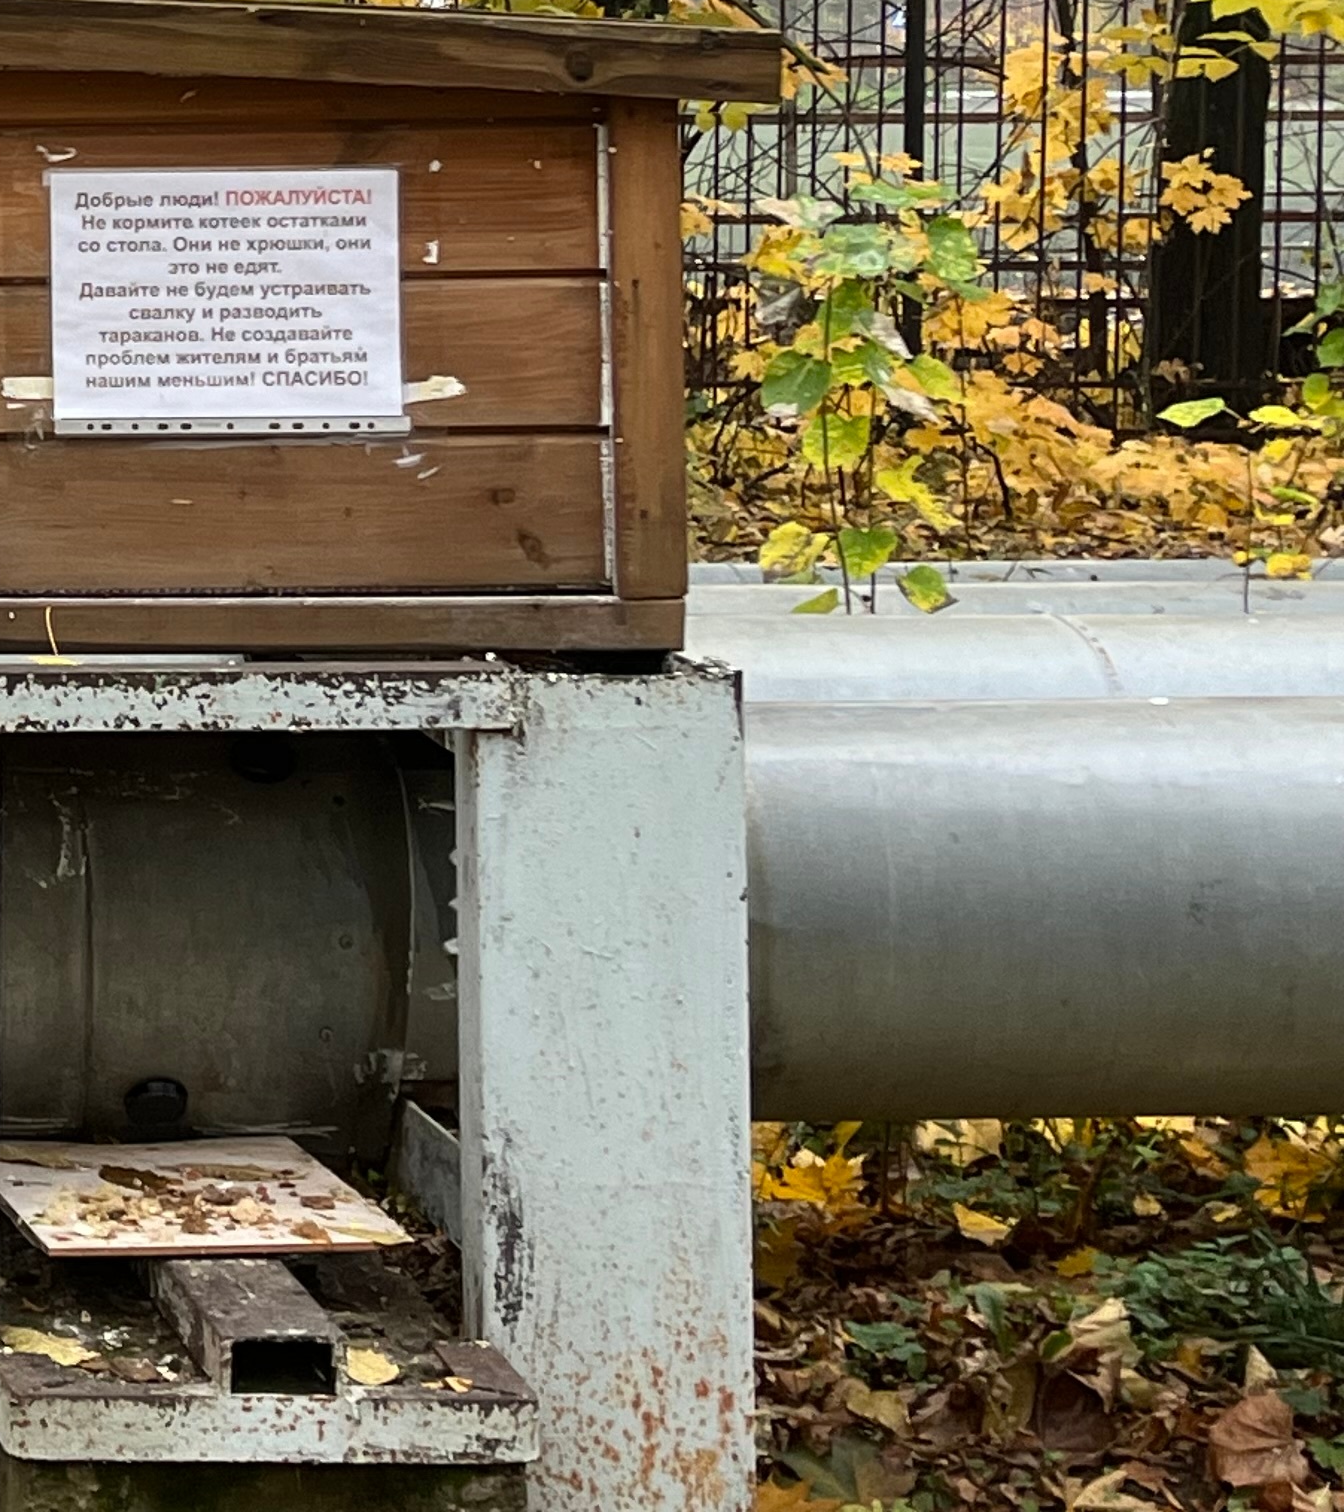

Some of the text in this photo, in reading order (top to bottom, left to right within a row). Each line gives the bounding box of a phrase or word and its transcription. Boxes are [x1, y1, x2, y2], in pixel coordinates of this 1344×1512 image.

[74, 186, 373, 210] Добрые люди! ПОЖАЛУЙСТА!
[81, 214, 367, 233] Не кормите котеек остатками
[78, 236, 371, 254] со стола. Они не хрюшки, они
[168, 261, 282, 276] это не едят.
[79, 281, 372, 301] Давайте не будем устраивать
[128, 306, 323, 323] свалку и разводить
[98, 325, 353, 346] тараканов. Не создавайте
[85, 347, 367, 369] проблем жителям и братьям
[86, 369, 369, 388] нашим меньшим! СПАСИБО!
